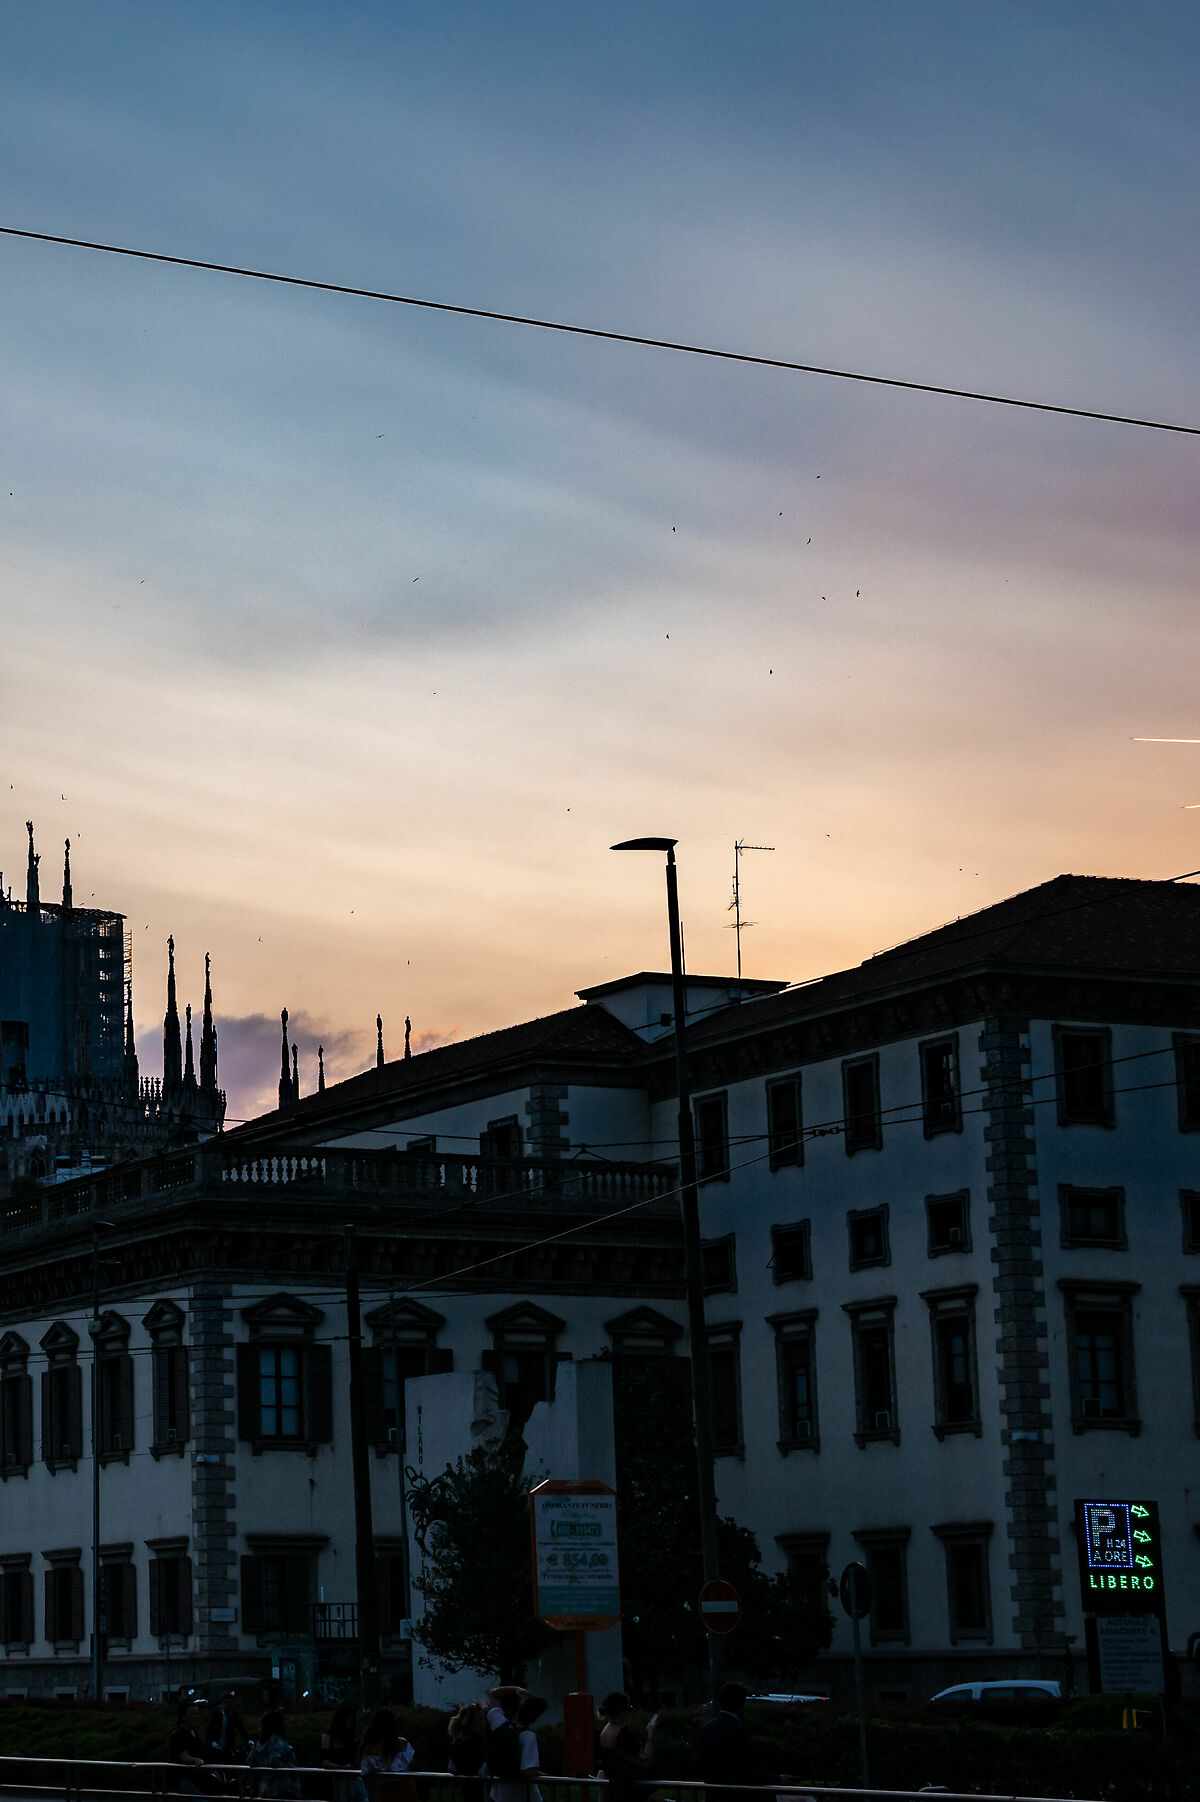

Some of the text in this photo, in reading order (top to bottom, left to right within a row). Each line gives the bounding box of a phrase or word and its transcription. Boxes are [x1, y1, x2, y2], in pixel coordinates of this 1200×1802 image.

[1091, 1509, 1115, 1547] P
[1094, 1551, 1127, 1561] A ORE
[1090, 1575, 1154, 1589] LIBERO
